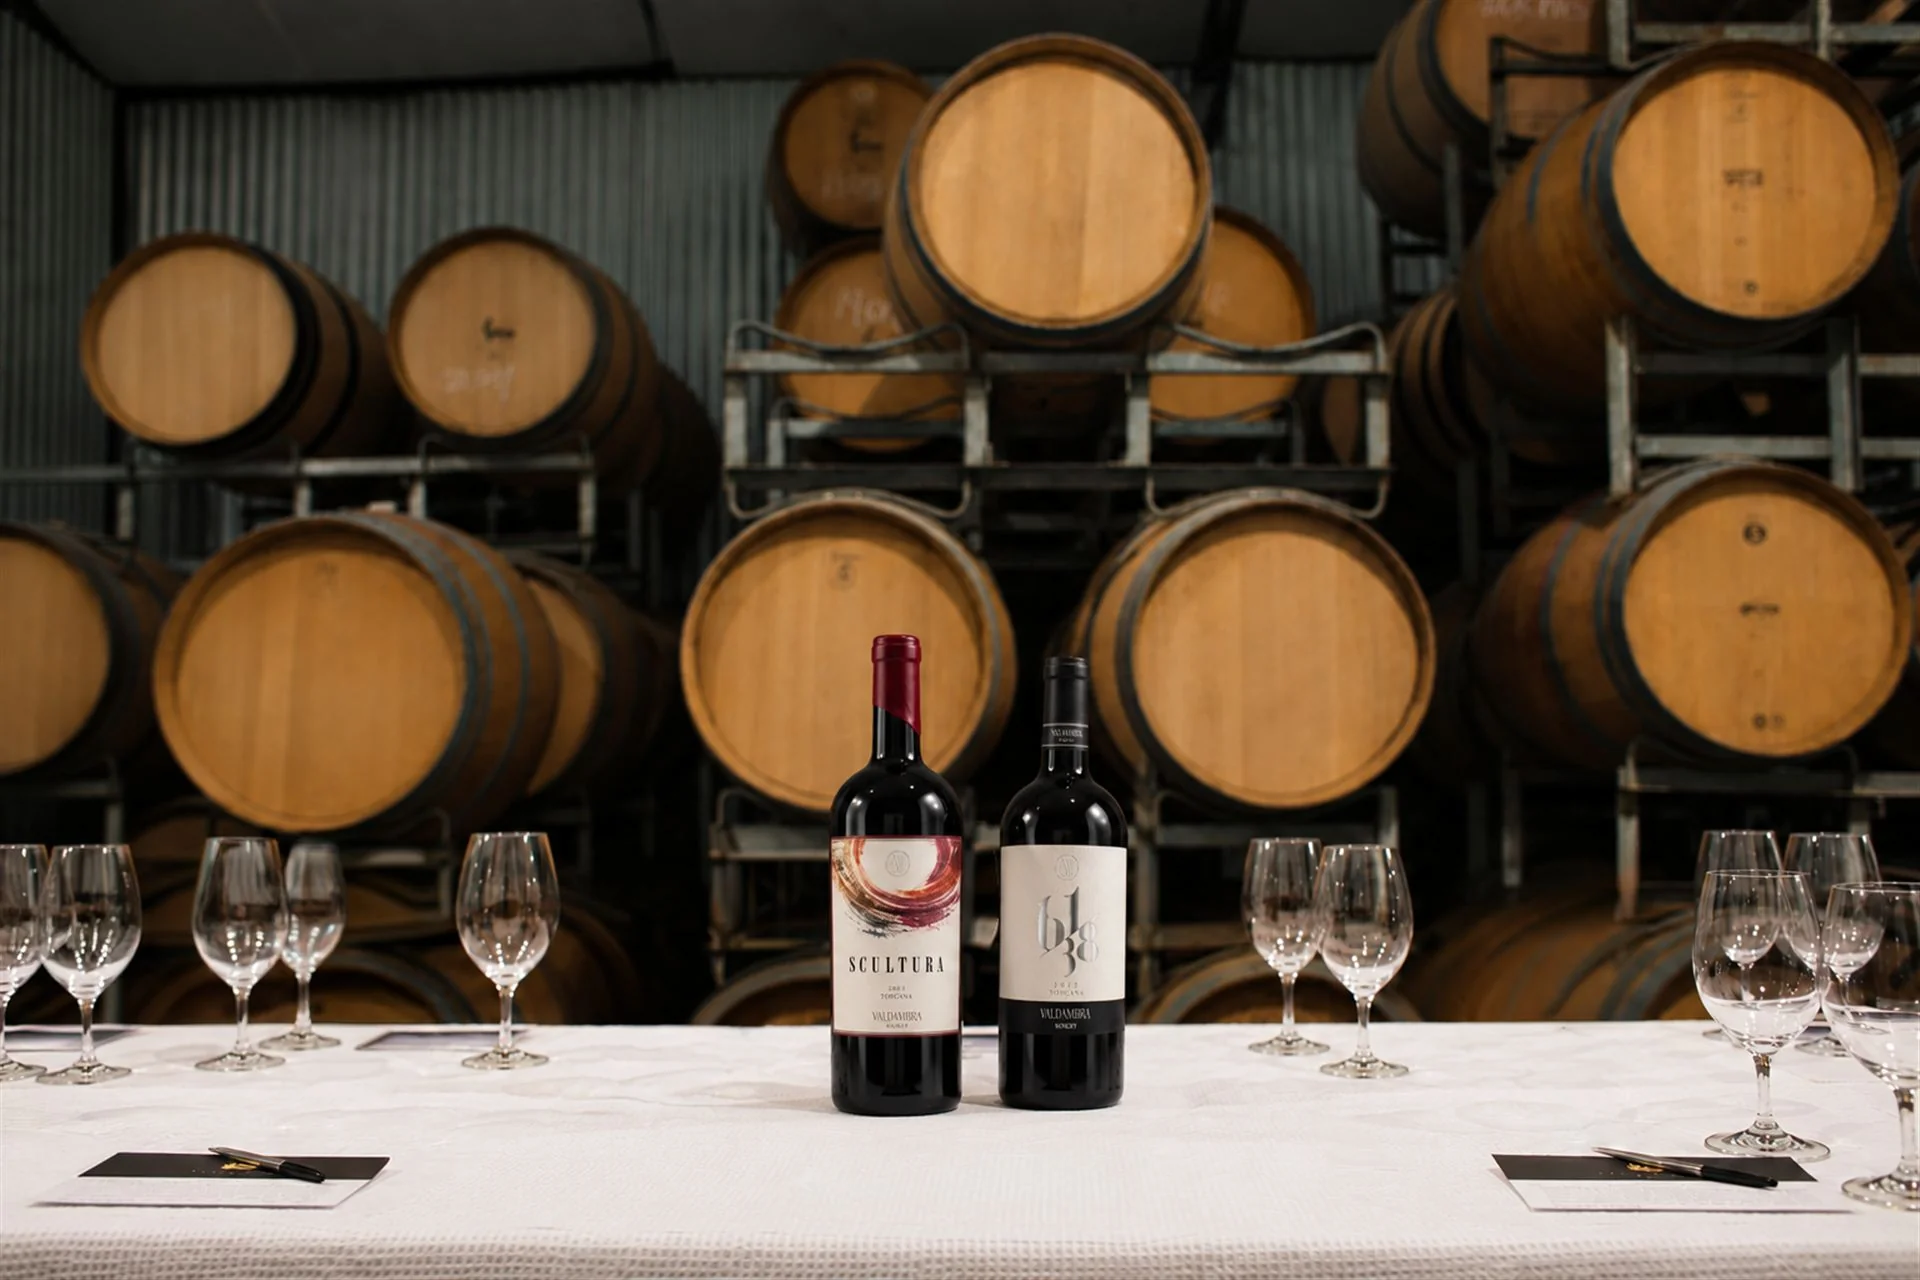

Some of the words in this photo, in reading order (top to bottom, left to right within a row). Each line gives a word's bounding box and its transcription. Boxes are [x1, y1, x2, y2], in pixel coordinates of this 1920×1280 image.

[849, 956, 944, 973] SCULTURA
[872, 1011, 922, 1021] VALDAMBRA
[1040, 1007, 1091, 1020] VALDAMBRA
